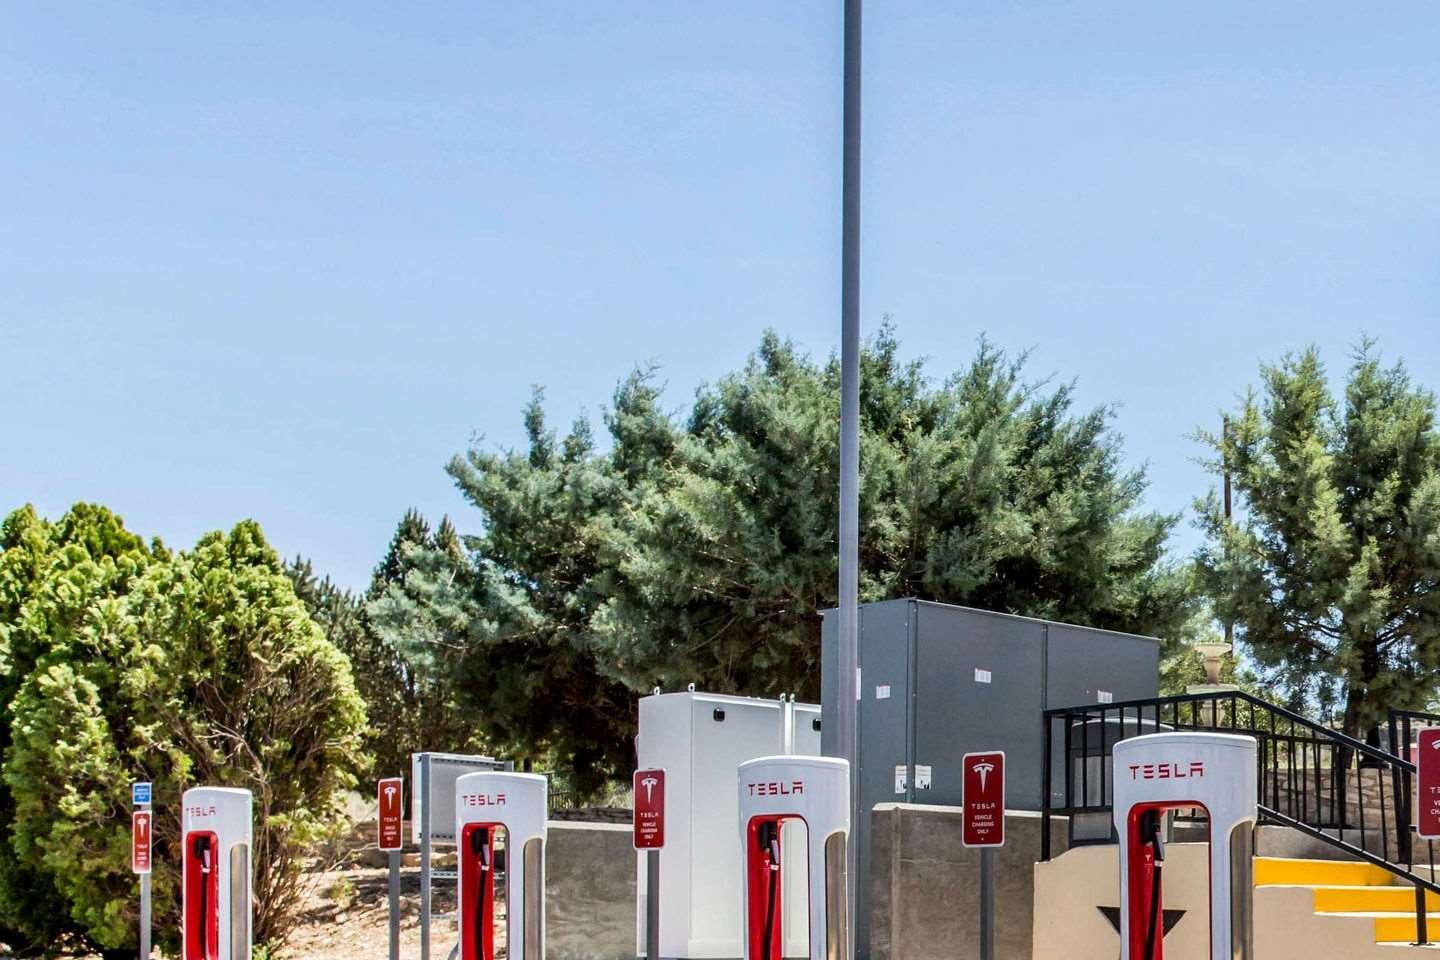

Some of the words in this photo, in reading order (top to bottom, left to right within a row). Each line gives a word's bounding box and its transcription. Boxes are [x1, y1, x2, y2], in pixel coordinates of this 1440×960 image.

[1129, 762, 1204, 780] TESLA
[747, 781, 804, 796] TESLA
[462, 794, 506, 808] TESLA
